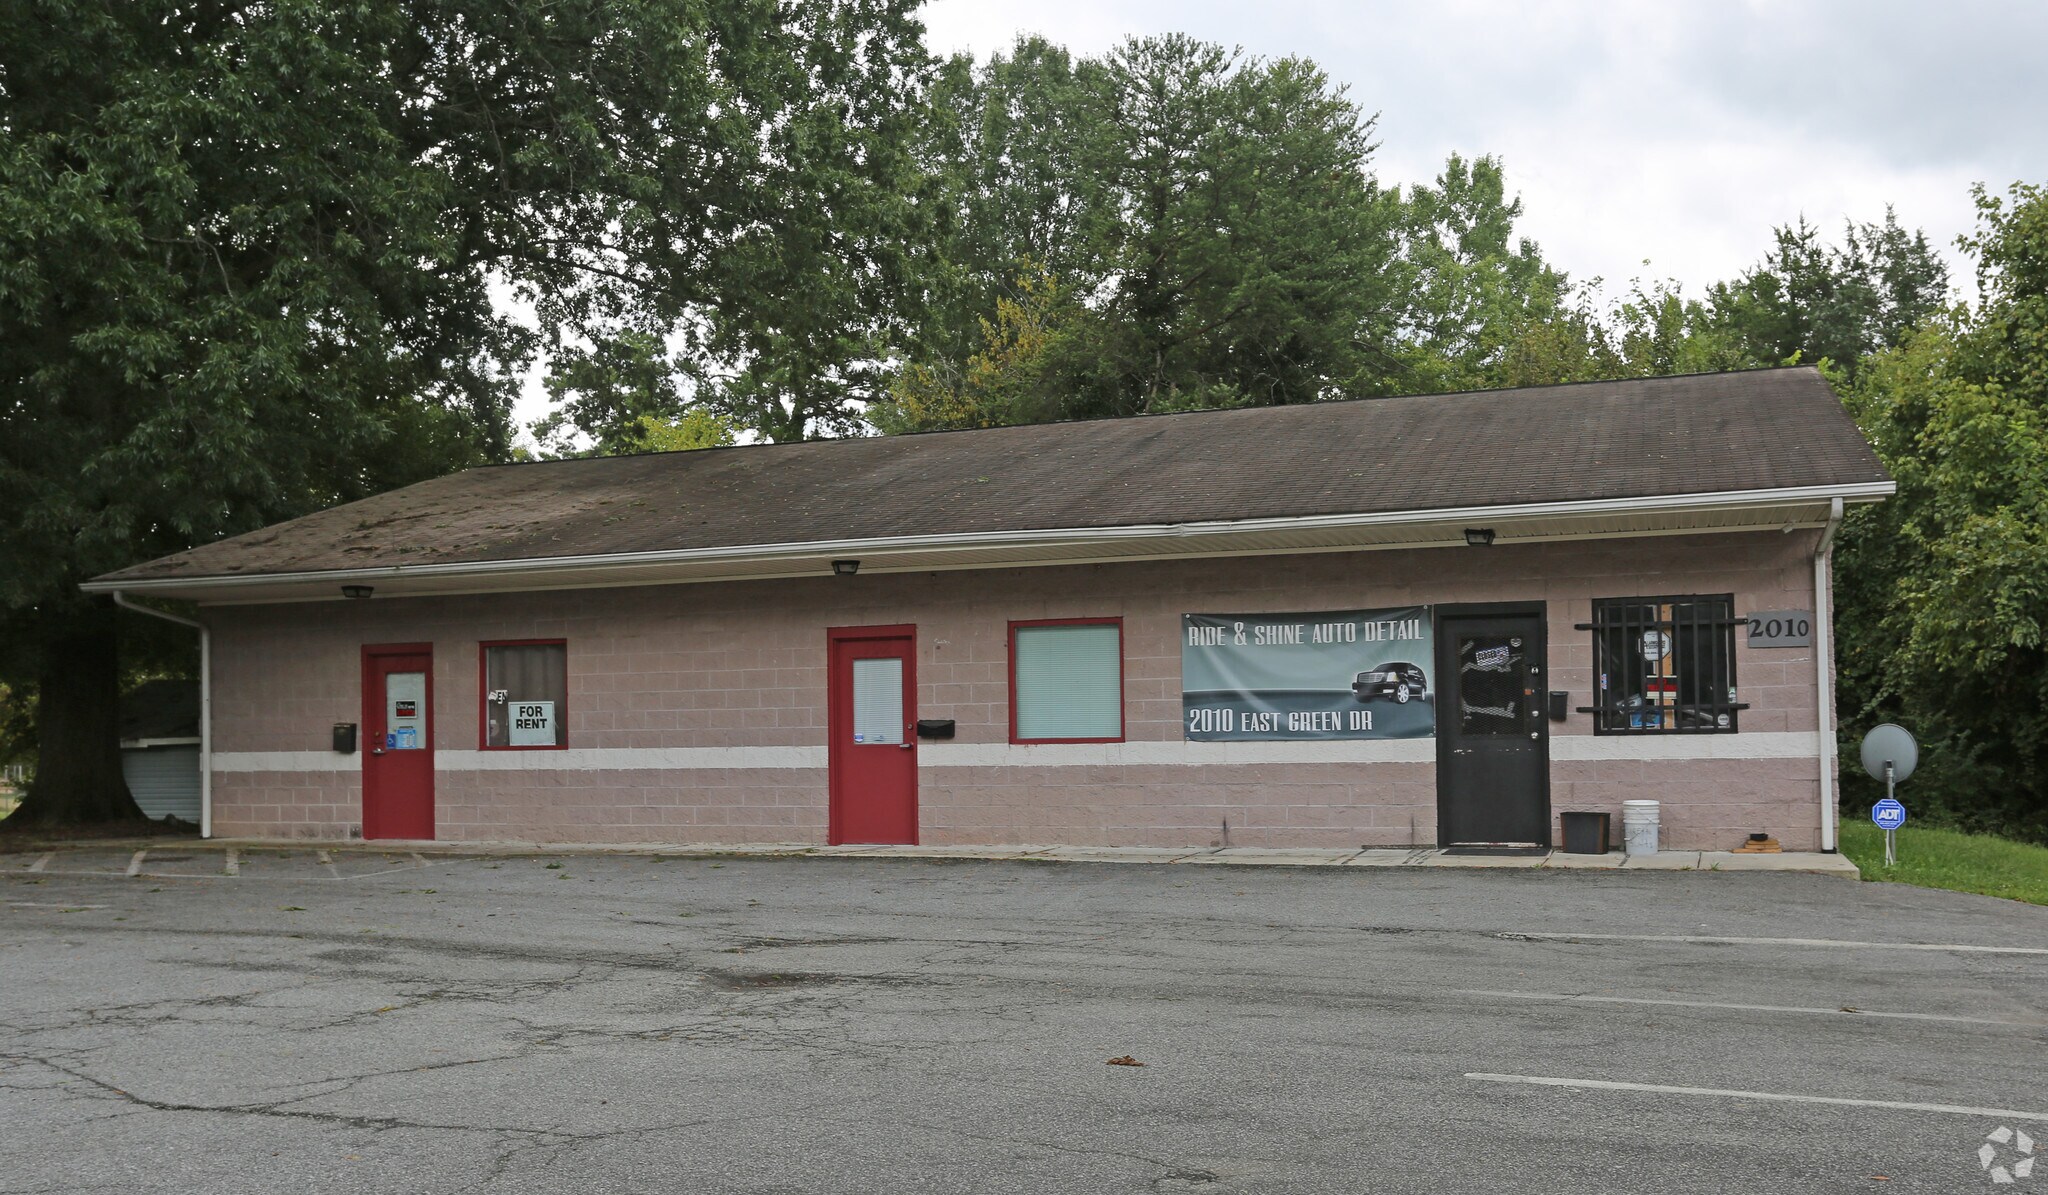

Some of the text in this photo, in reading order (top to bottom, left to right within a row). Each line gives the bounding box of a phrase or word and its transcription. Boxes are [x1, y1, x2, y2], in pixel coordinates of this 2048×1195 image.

[1188, 619, 1424, 646] RIDE & SHINE AUTO DETAIL
[1749, 618, 1809, 638] 2010
[519, 706, 543, 717] FOR
[516, 718, 547, 729] RENT
[1189, 708, 1373, 732] 2010 EAST GREEN DR
[1878, 809, 1900, 820] ADT
